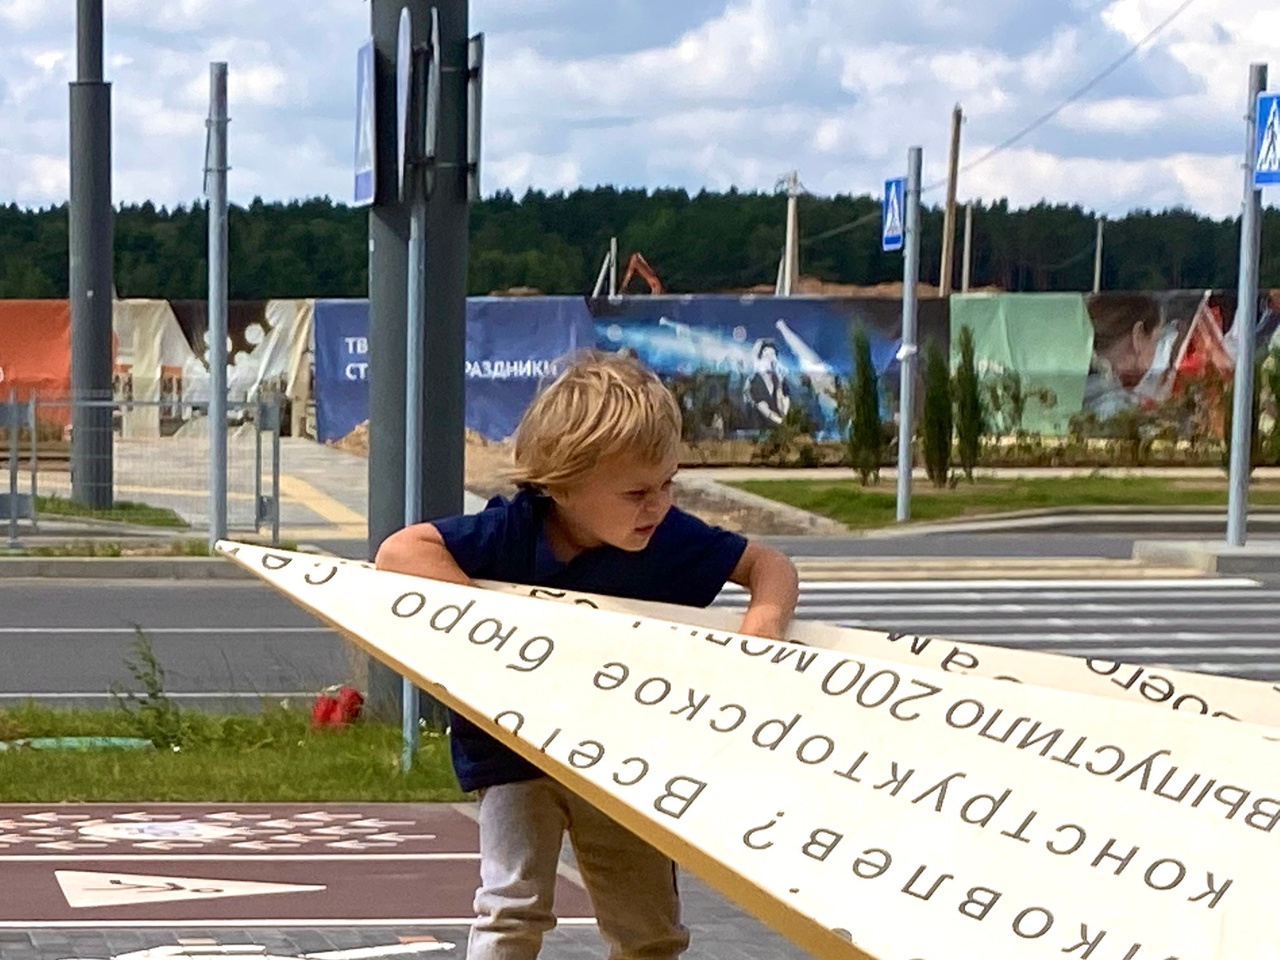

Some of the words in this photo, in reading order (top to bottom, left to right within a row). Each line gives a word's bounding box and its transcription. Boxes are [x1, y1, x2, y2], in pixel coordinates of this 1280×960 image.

[465, 359, 557, 380] РАЗДНИКИ
[391, 592, 555, 672] бюро
[821, 659, 942, 720] 200
[593, 662, 1233, 908] конструкторское
[945, 699, 1280, 832] выпустило
